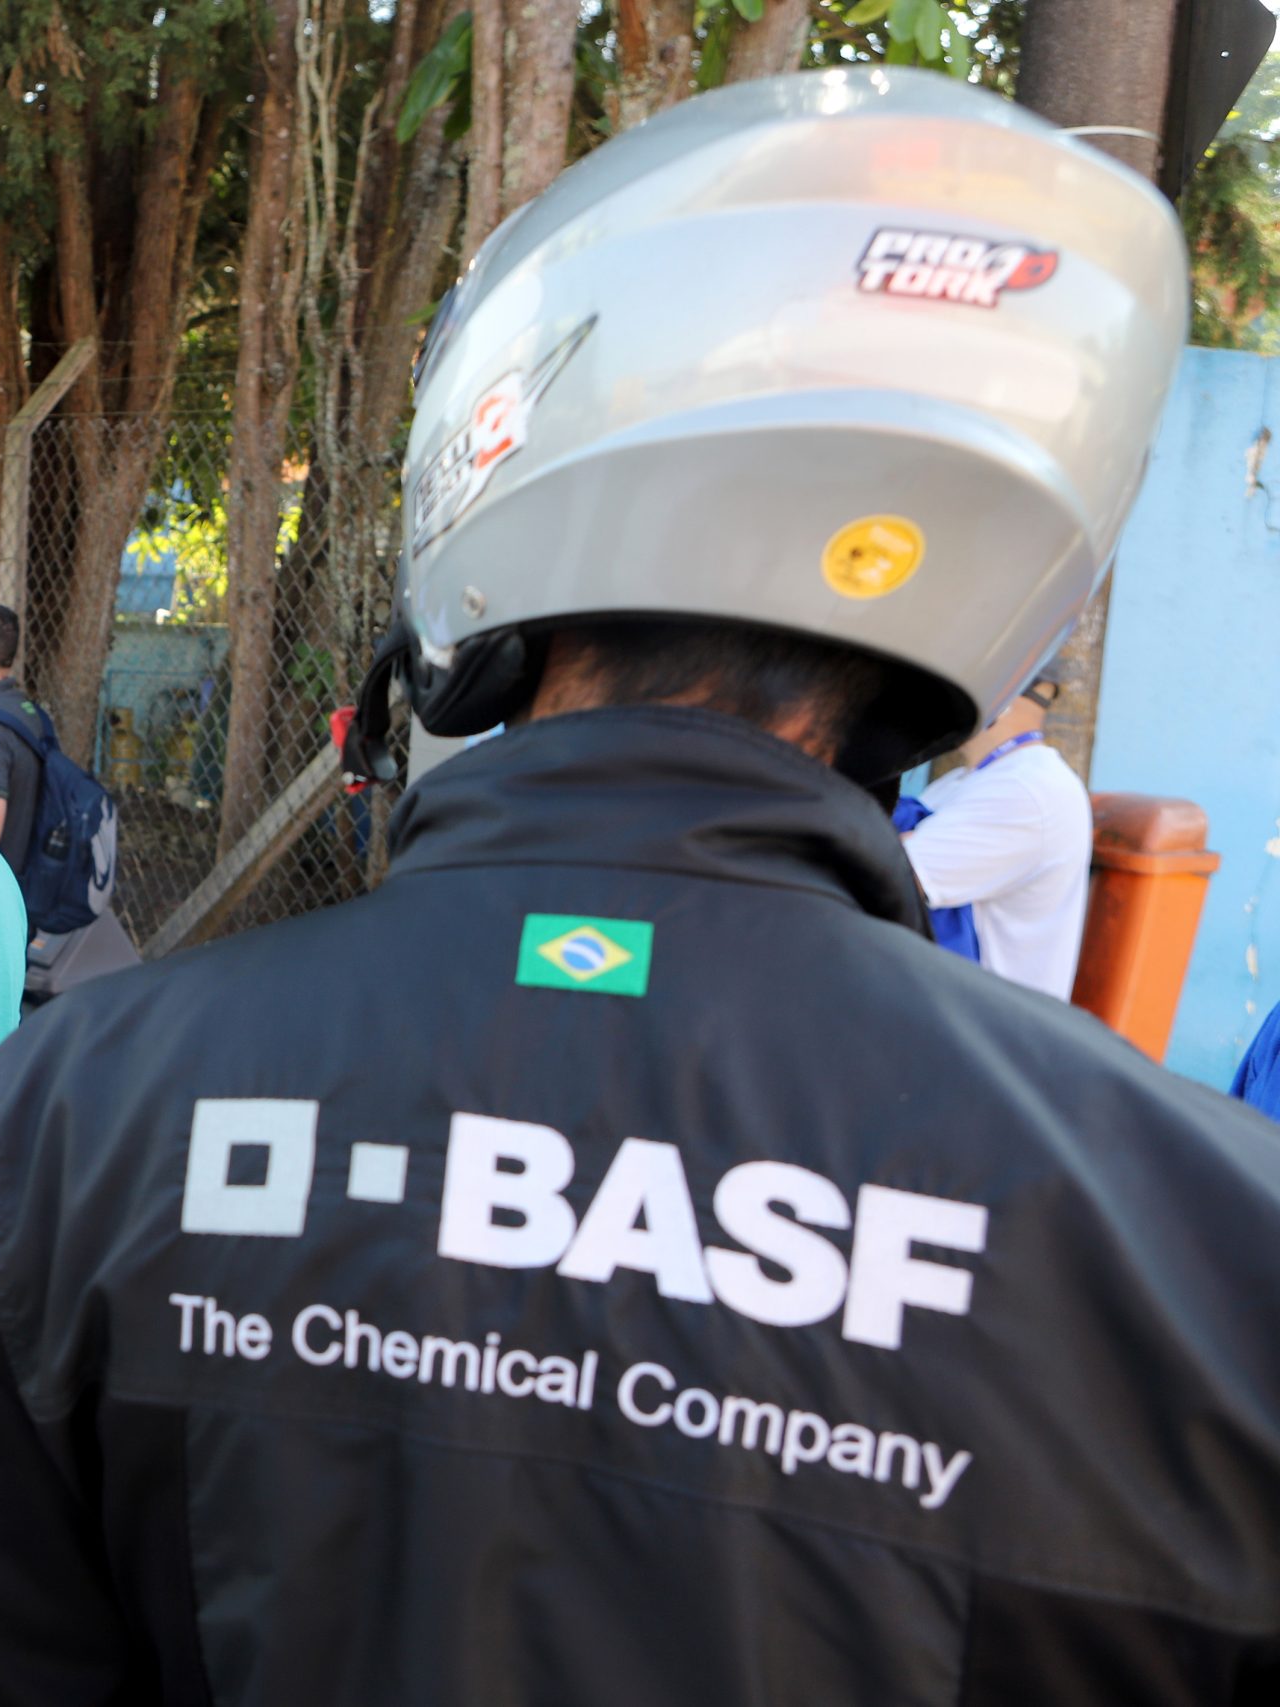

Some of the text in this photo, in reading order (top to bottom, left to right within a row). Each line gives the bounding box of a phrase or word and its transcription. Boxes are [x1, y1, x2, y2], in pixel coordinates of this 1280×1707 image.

[858, 252, 1022, 305] TORK
[864, 230, 988, 268] PRO
[438, 1112, 988, 1349] BASF
[170, 1294, 973, 1508] The Chemical Company
